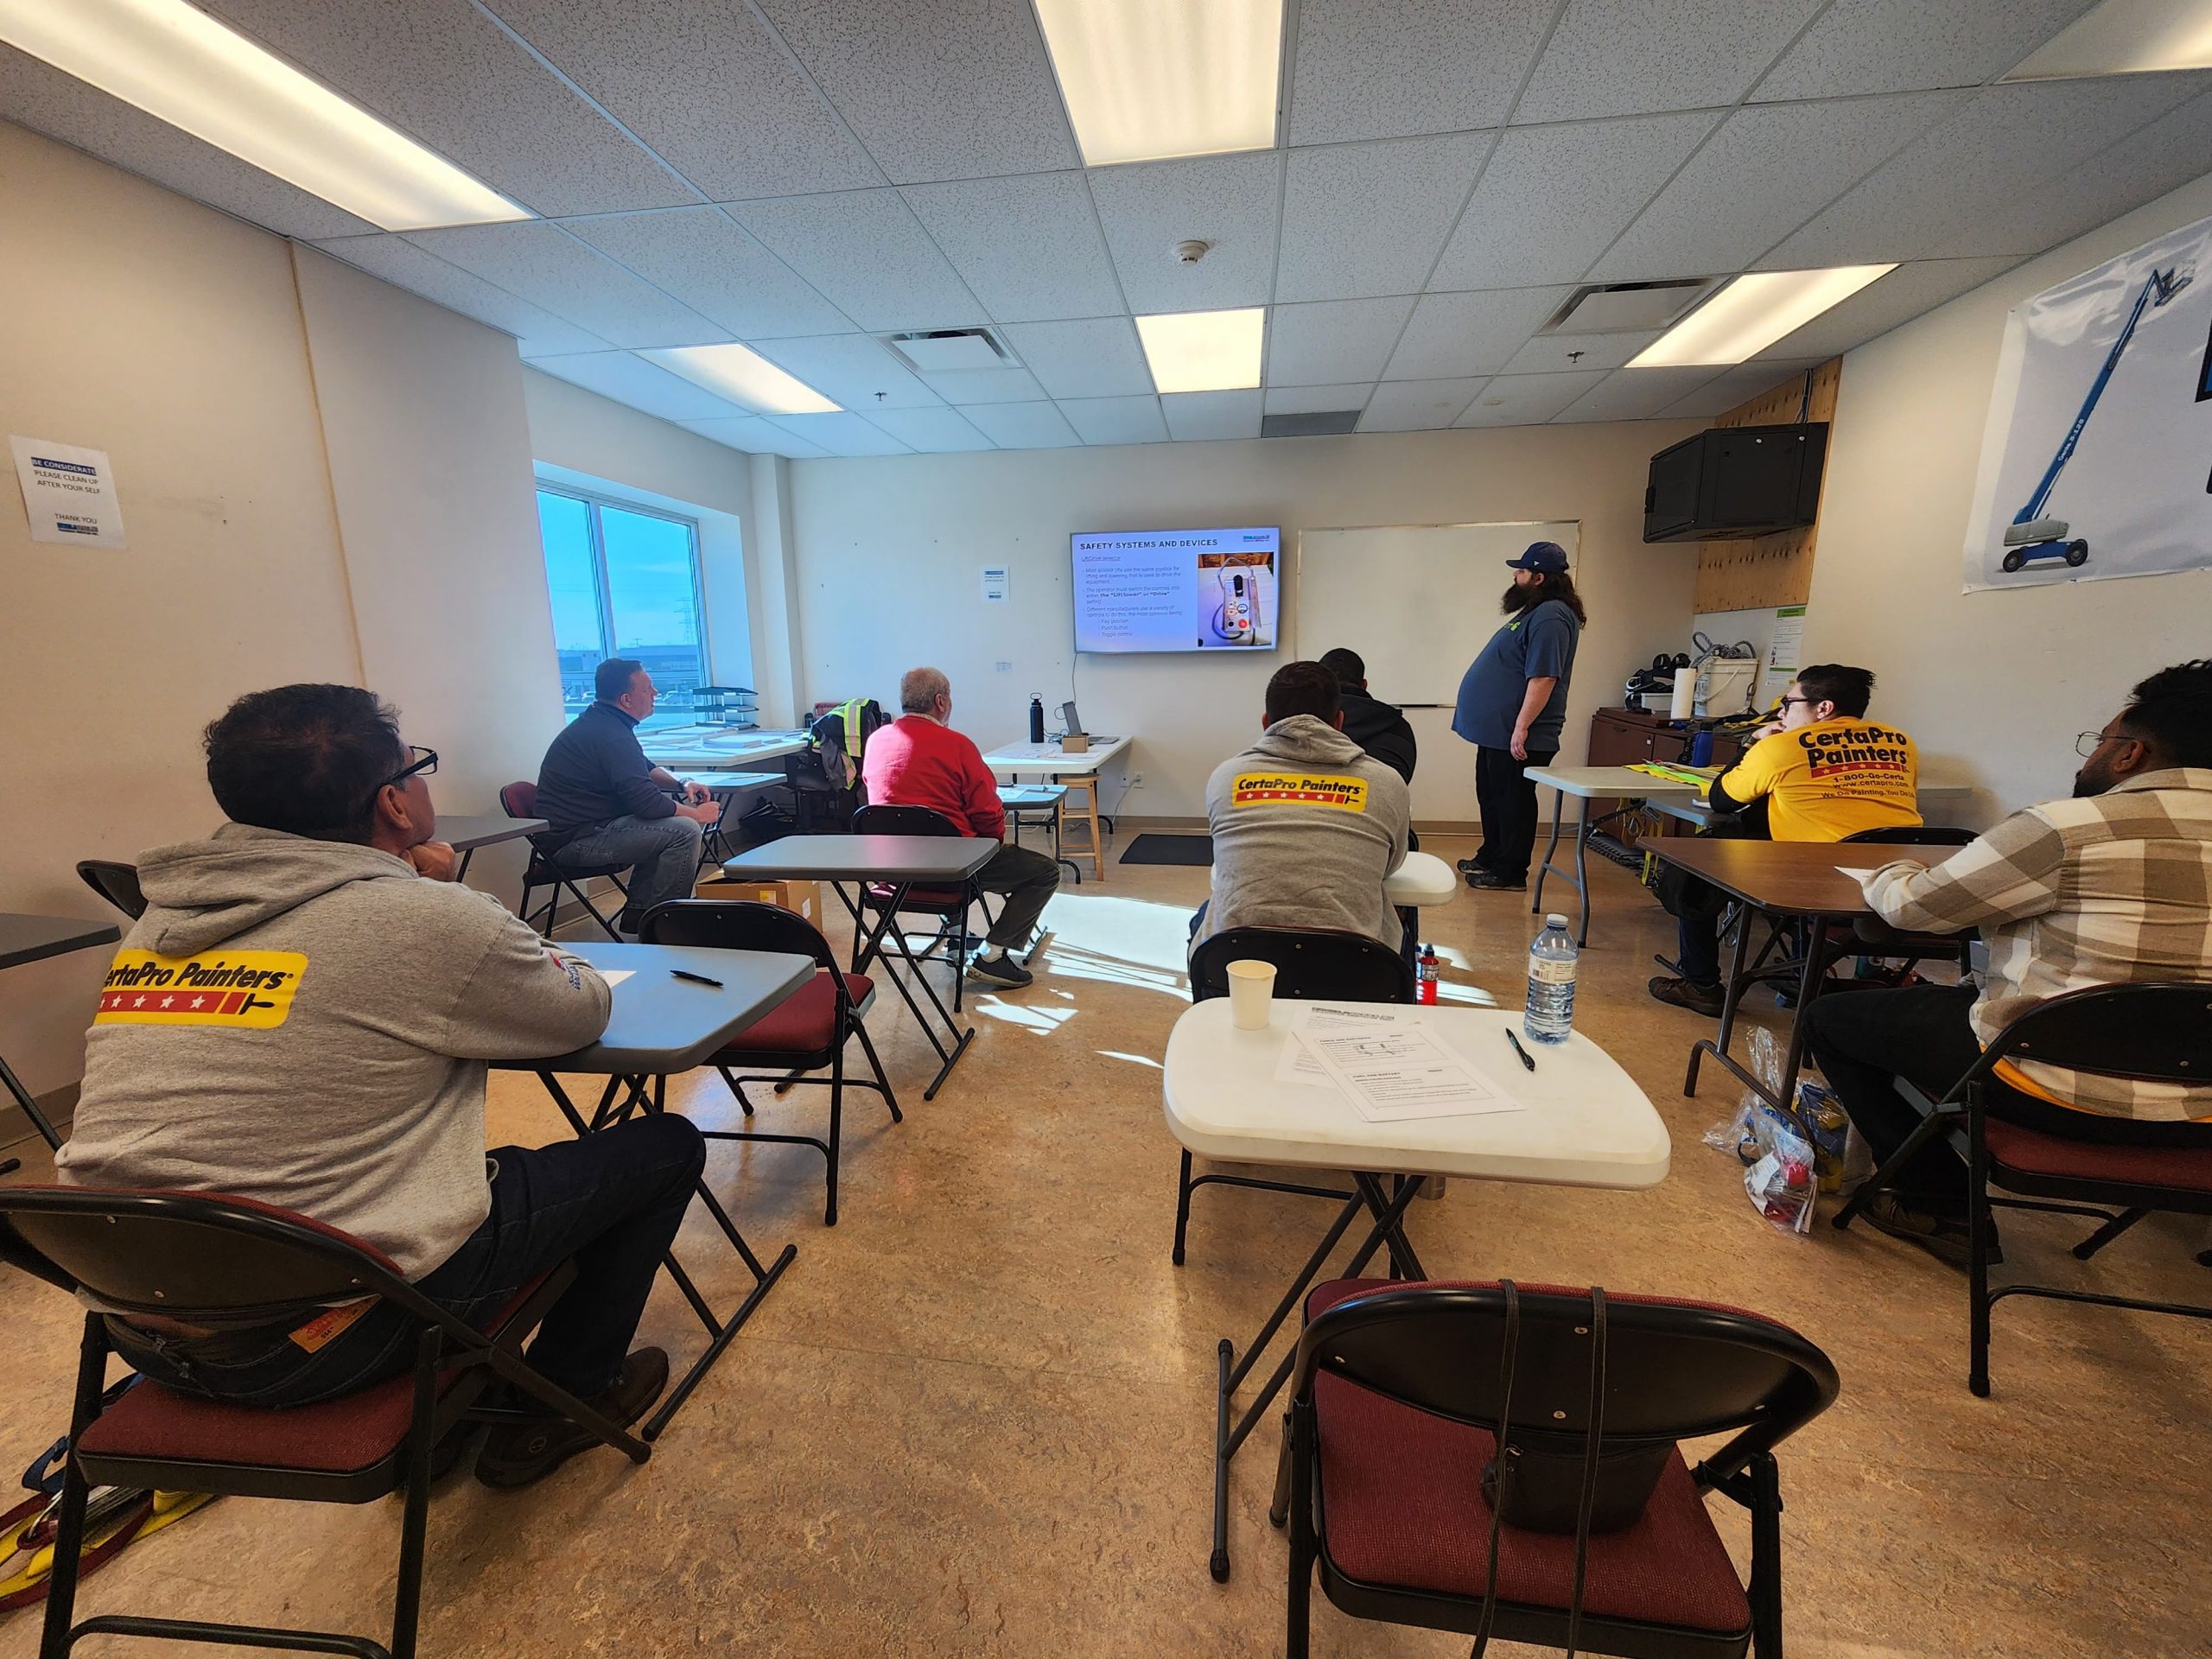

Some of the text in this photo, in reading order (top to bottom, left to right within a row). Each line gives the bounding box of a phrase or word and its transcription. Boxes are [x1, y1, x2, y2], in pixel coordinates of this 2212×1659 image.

[32, 458, 97, 474] BE CONSIDERATE
[35, 470, 62, 480] PLEASE
[63, 474, 87, 483] CLEAN
[37, 480, 61, 489] AFTER
[54, 513, 80, 523] THANK
[1080, 542, 1113, 550] SAFETY
[1799, 727, 1907, 748] CertaPro
[1807, 744, 1908, 769] Painters
[1832, 779, 1910, 789] www.certapro.com
[1833, 772, 1905, 783] 1-800-Go-Certa
[1238, 778, 1361, 795] CertaPro Painters
[103, 961, 288, 990] ertaPro Painters
